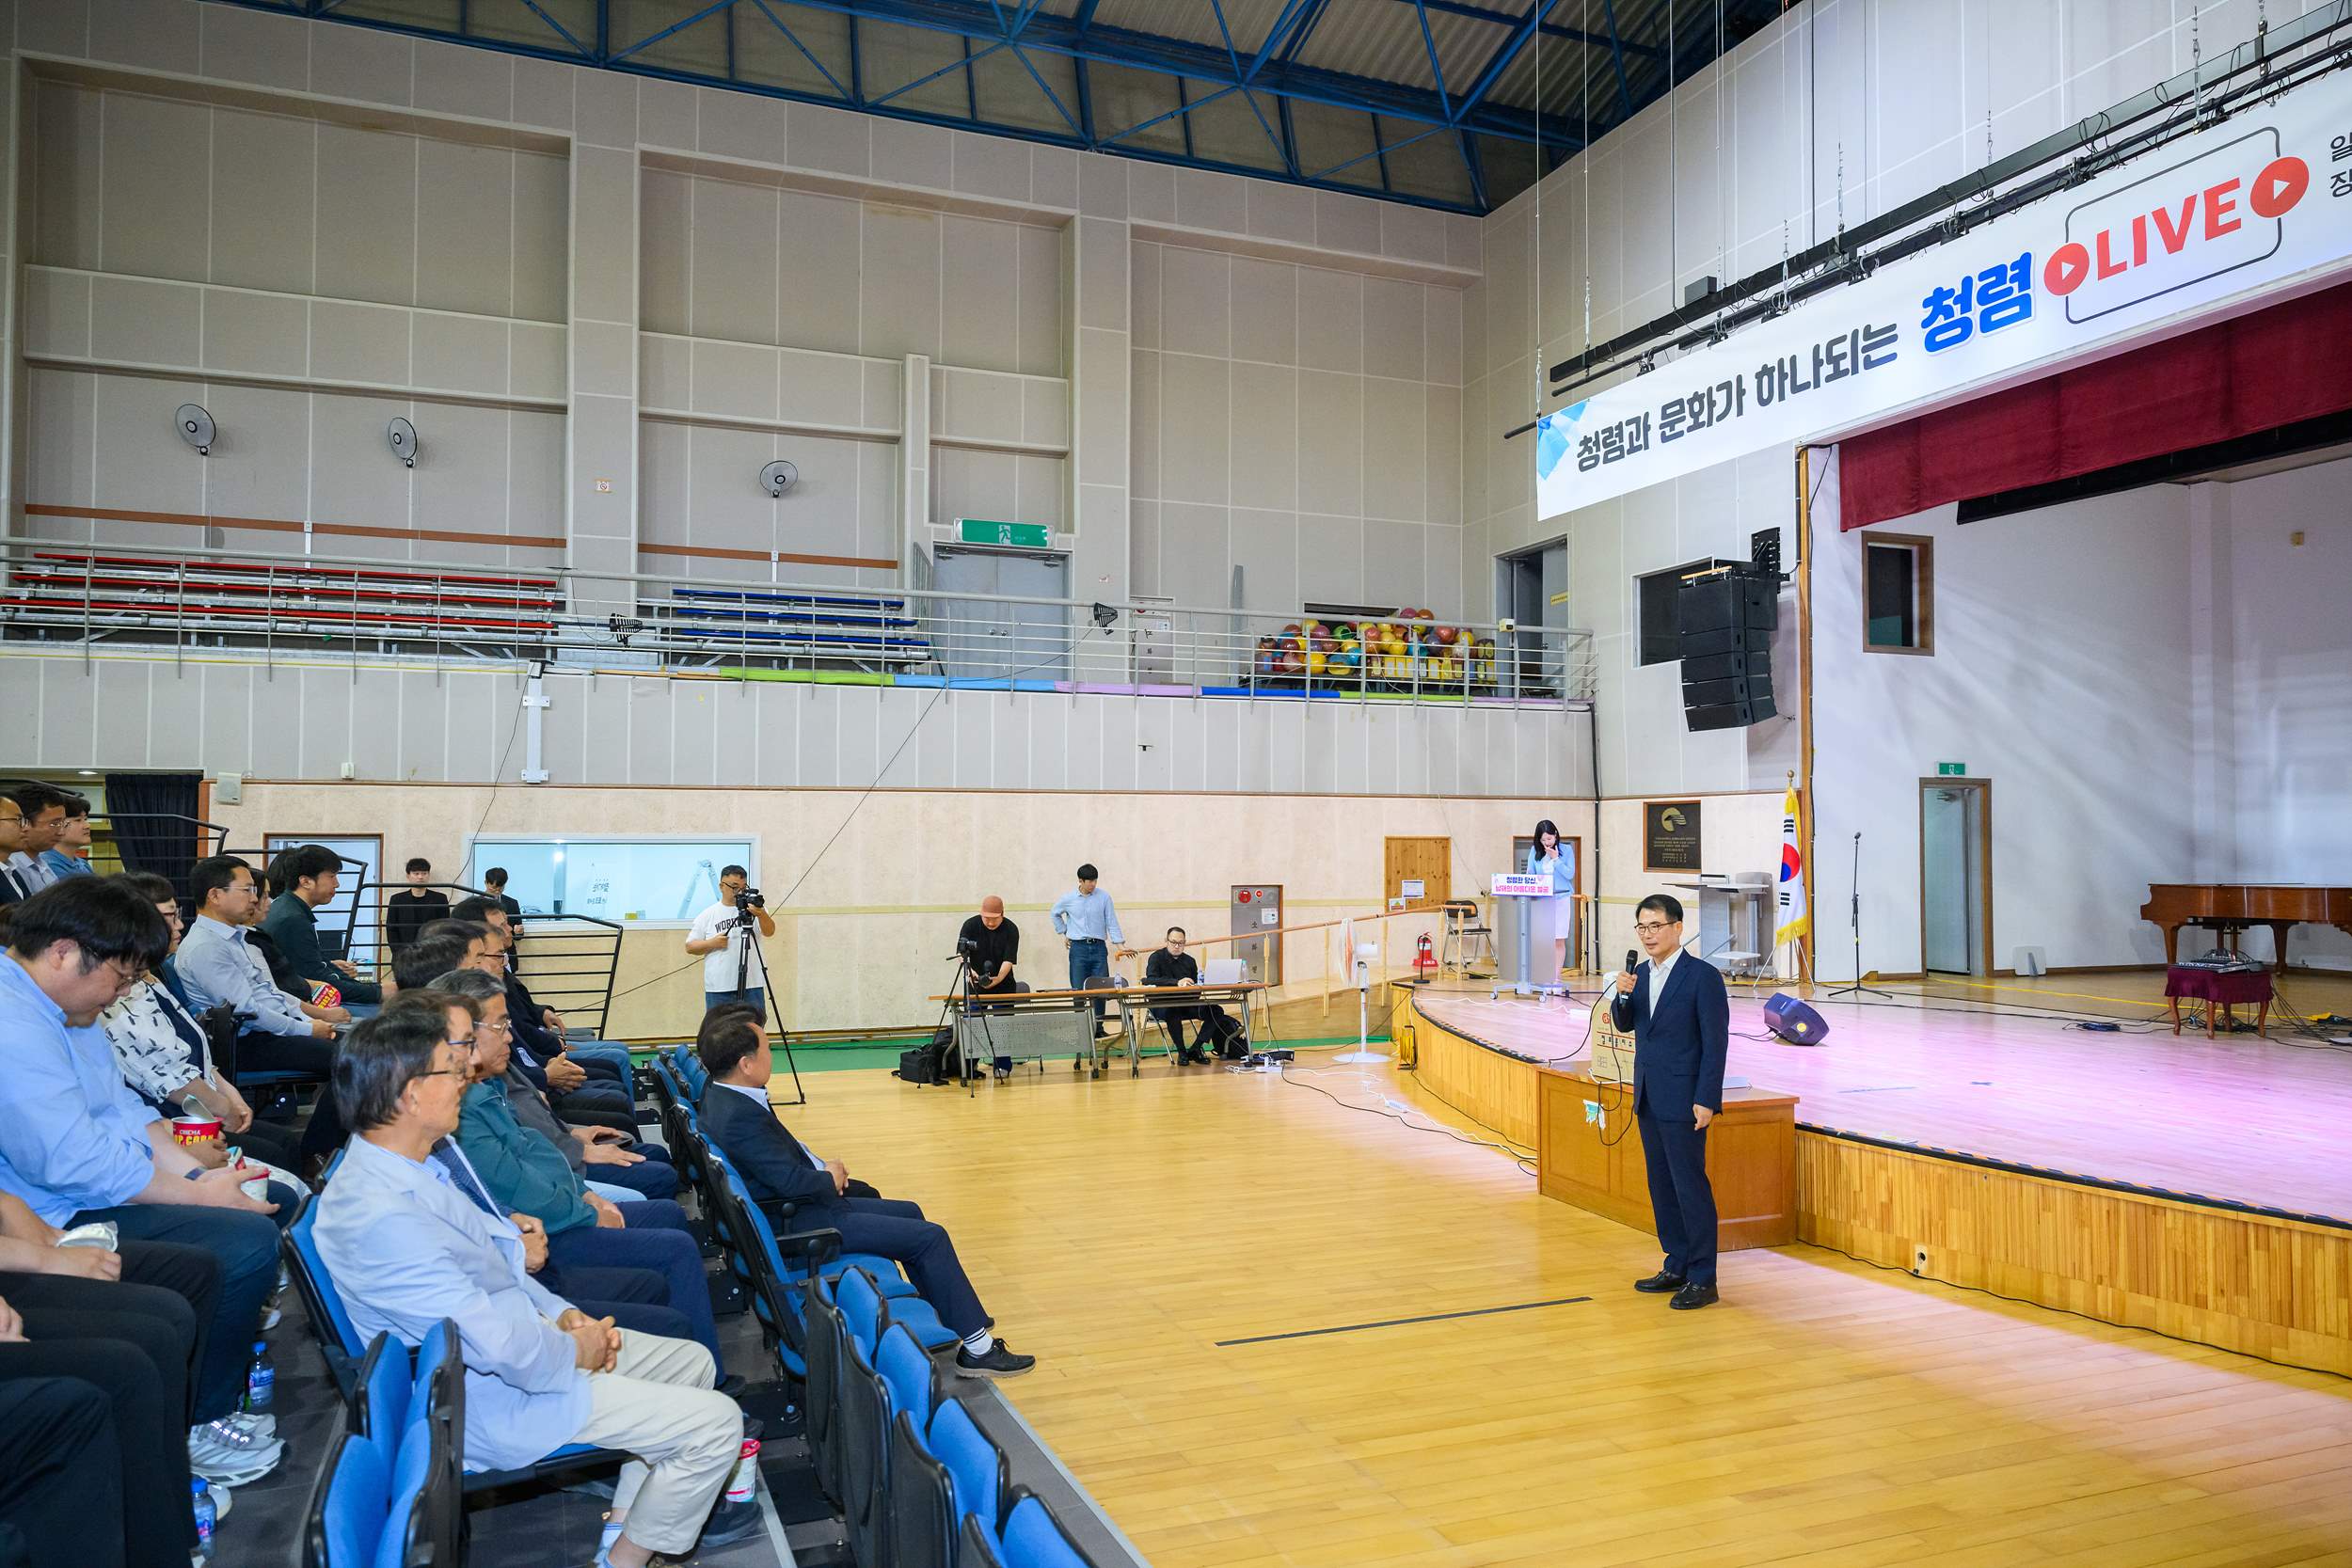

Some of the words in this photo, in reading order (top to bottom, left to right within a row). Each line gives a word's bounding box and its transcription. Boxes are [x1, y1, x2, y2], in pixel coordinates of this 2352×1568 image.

[1577, 411, 1651, 472] 청렴과
[1659, 373, 1746, 444] 문화가
[1755, 323, 1899, 407] 하나되는
[1920, 251, 2032, 353] 청렴
[2096, 177, 2242, 281] LIVE
